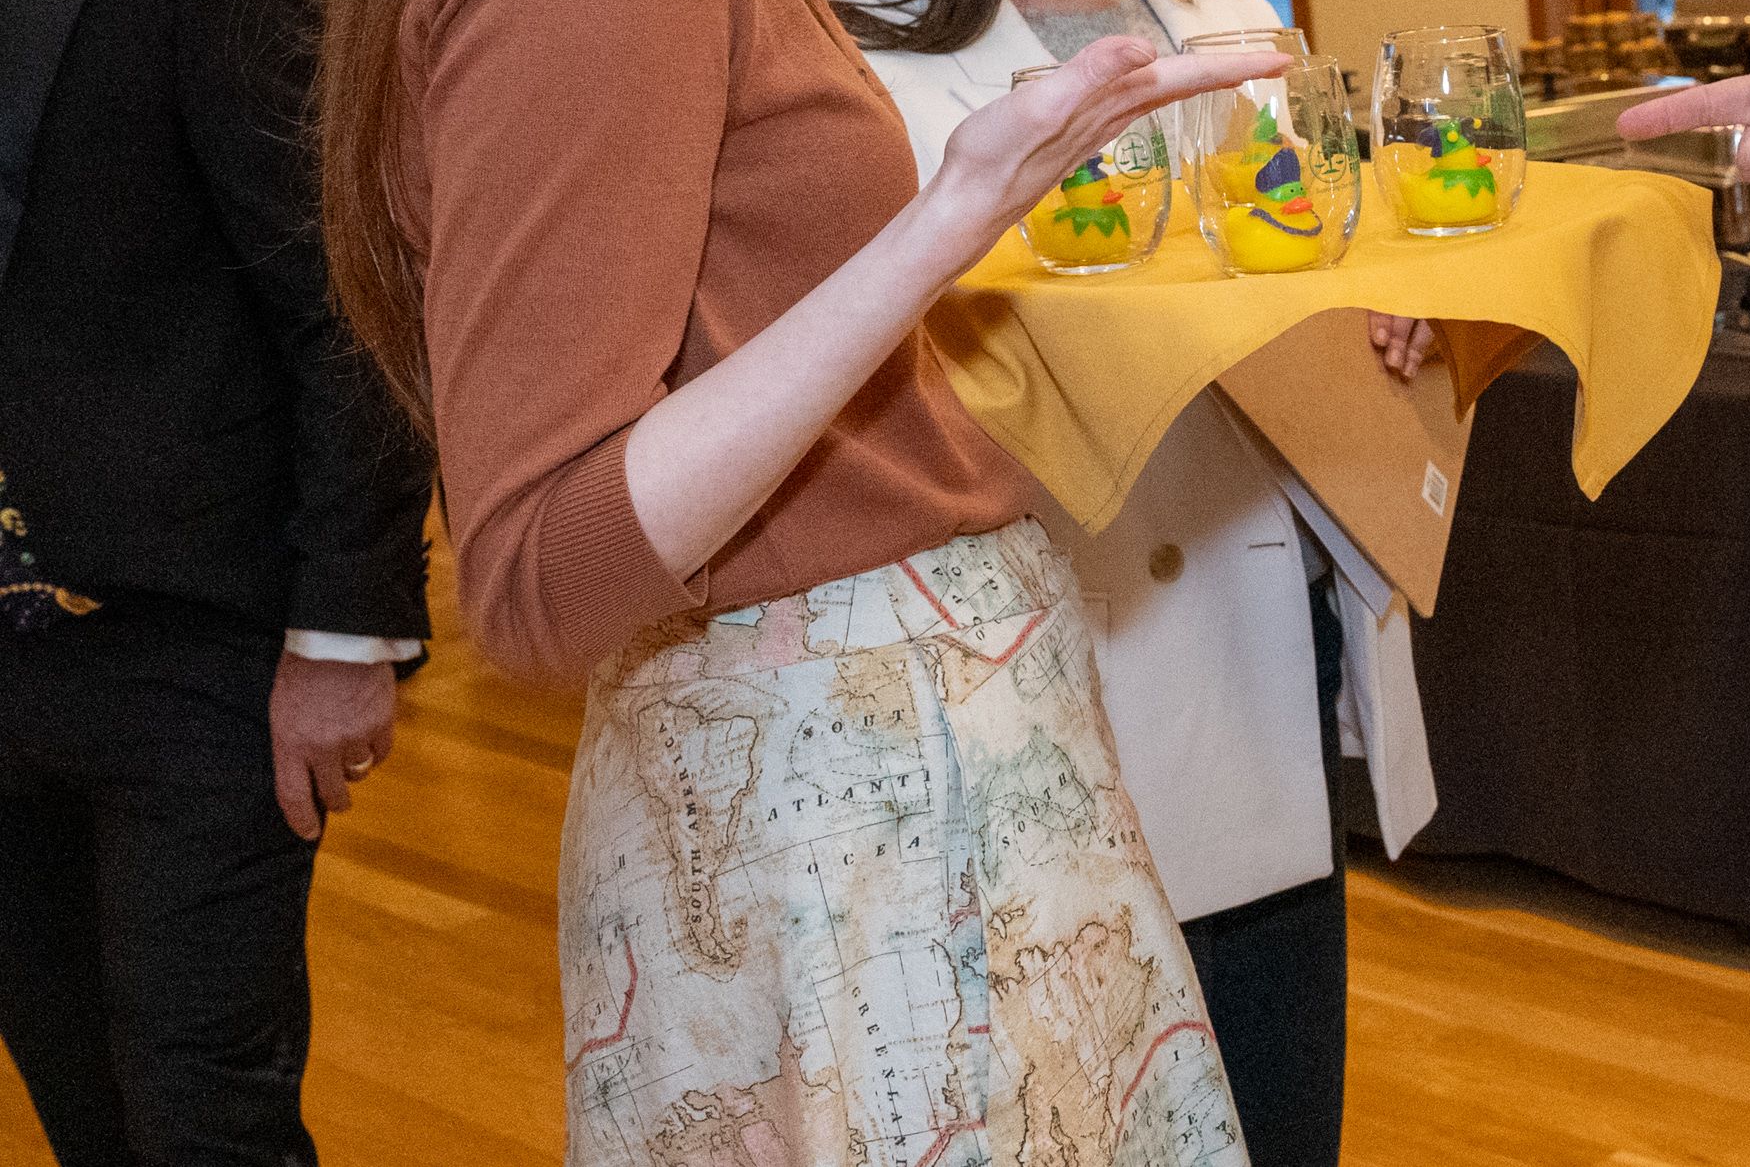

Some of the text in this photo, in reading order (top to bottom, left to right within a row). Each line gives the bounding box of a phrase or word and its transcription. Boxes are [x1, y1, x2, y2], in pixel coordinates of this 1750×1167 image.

[803, 709, 905, 740] SOUT
[767, 770, 931, 822] ATLANTI
[1001, 772, 1067, 850] SOUTH
[659, 722, 702, 924] SOUTH AMERICA
[807, 835, 921, 875] OCEA
